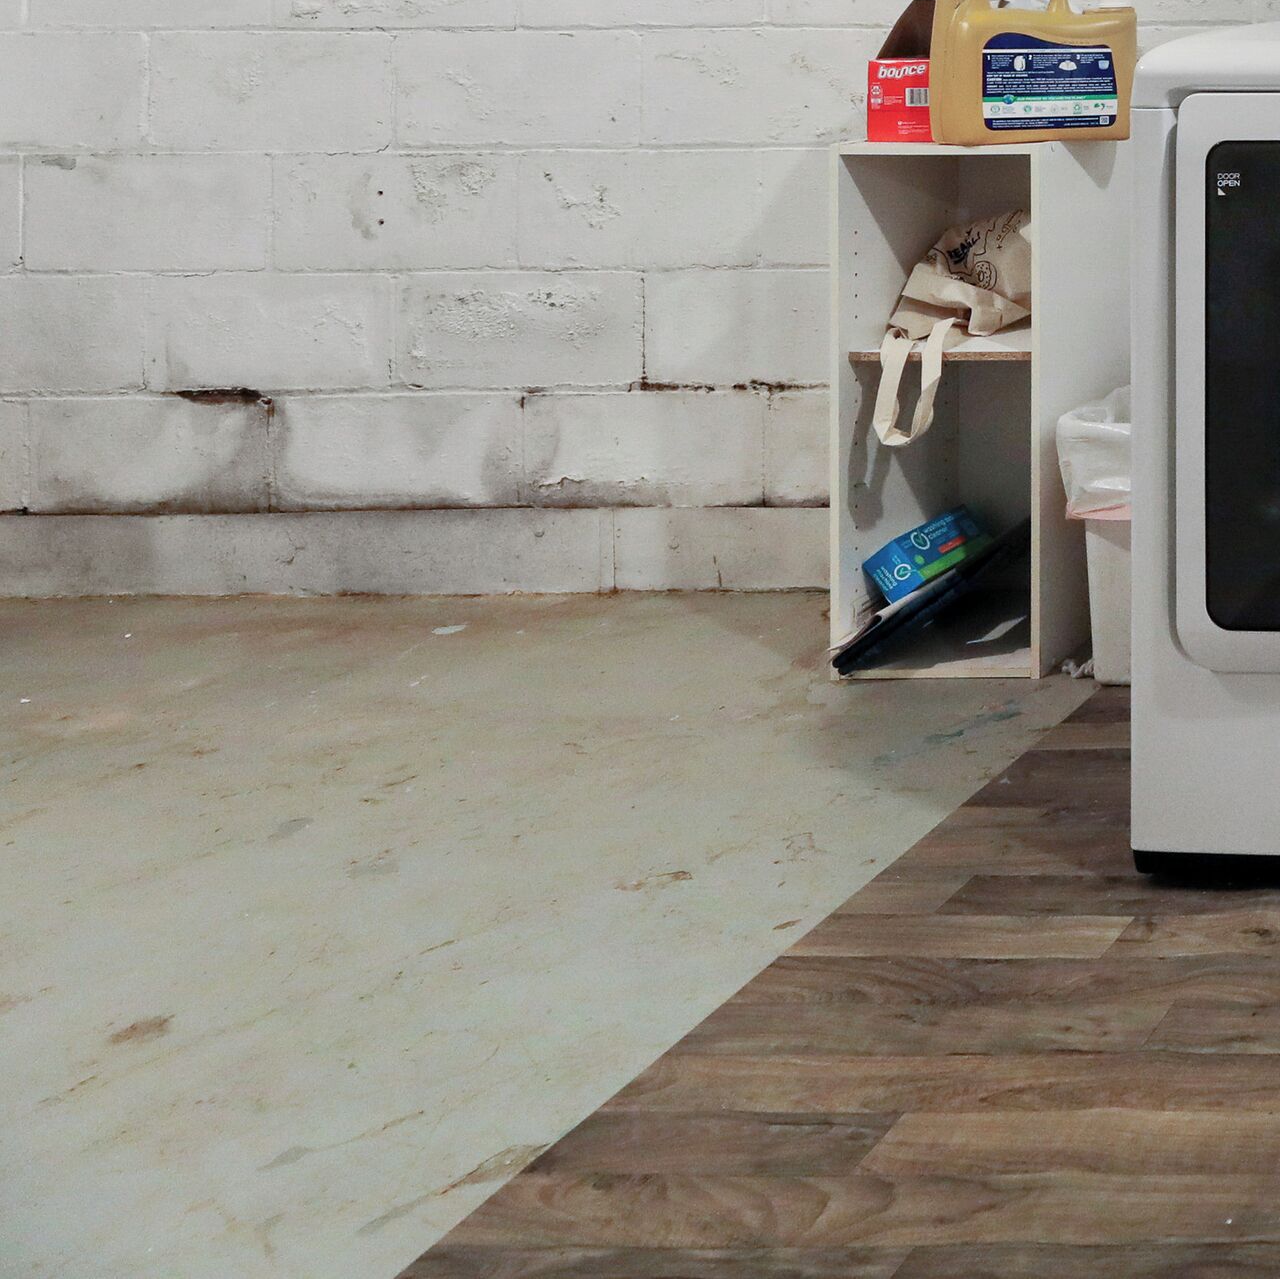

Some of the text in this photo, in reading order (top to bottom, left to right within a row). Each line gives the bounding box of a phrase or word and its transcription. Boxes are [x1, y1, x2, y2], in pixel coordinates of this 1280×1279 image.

[878, 64, 927, 79] bounce
[1217, 172, 1241, 180] DOOR
[1217, 179, 1241, 187] OPEN
